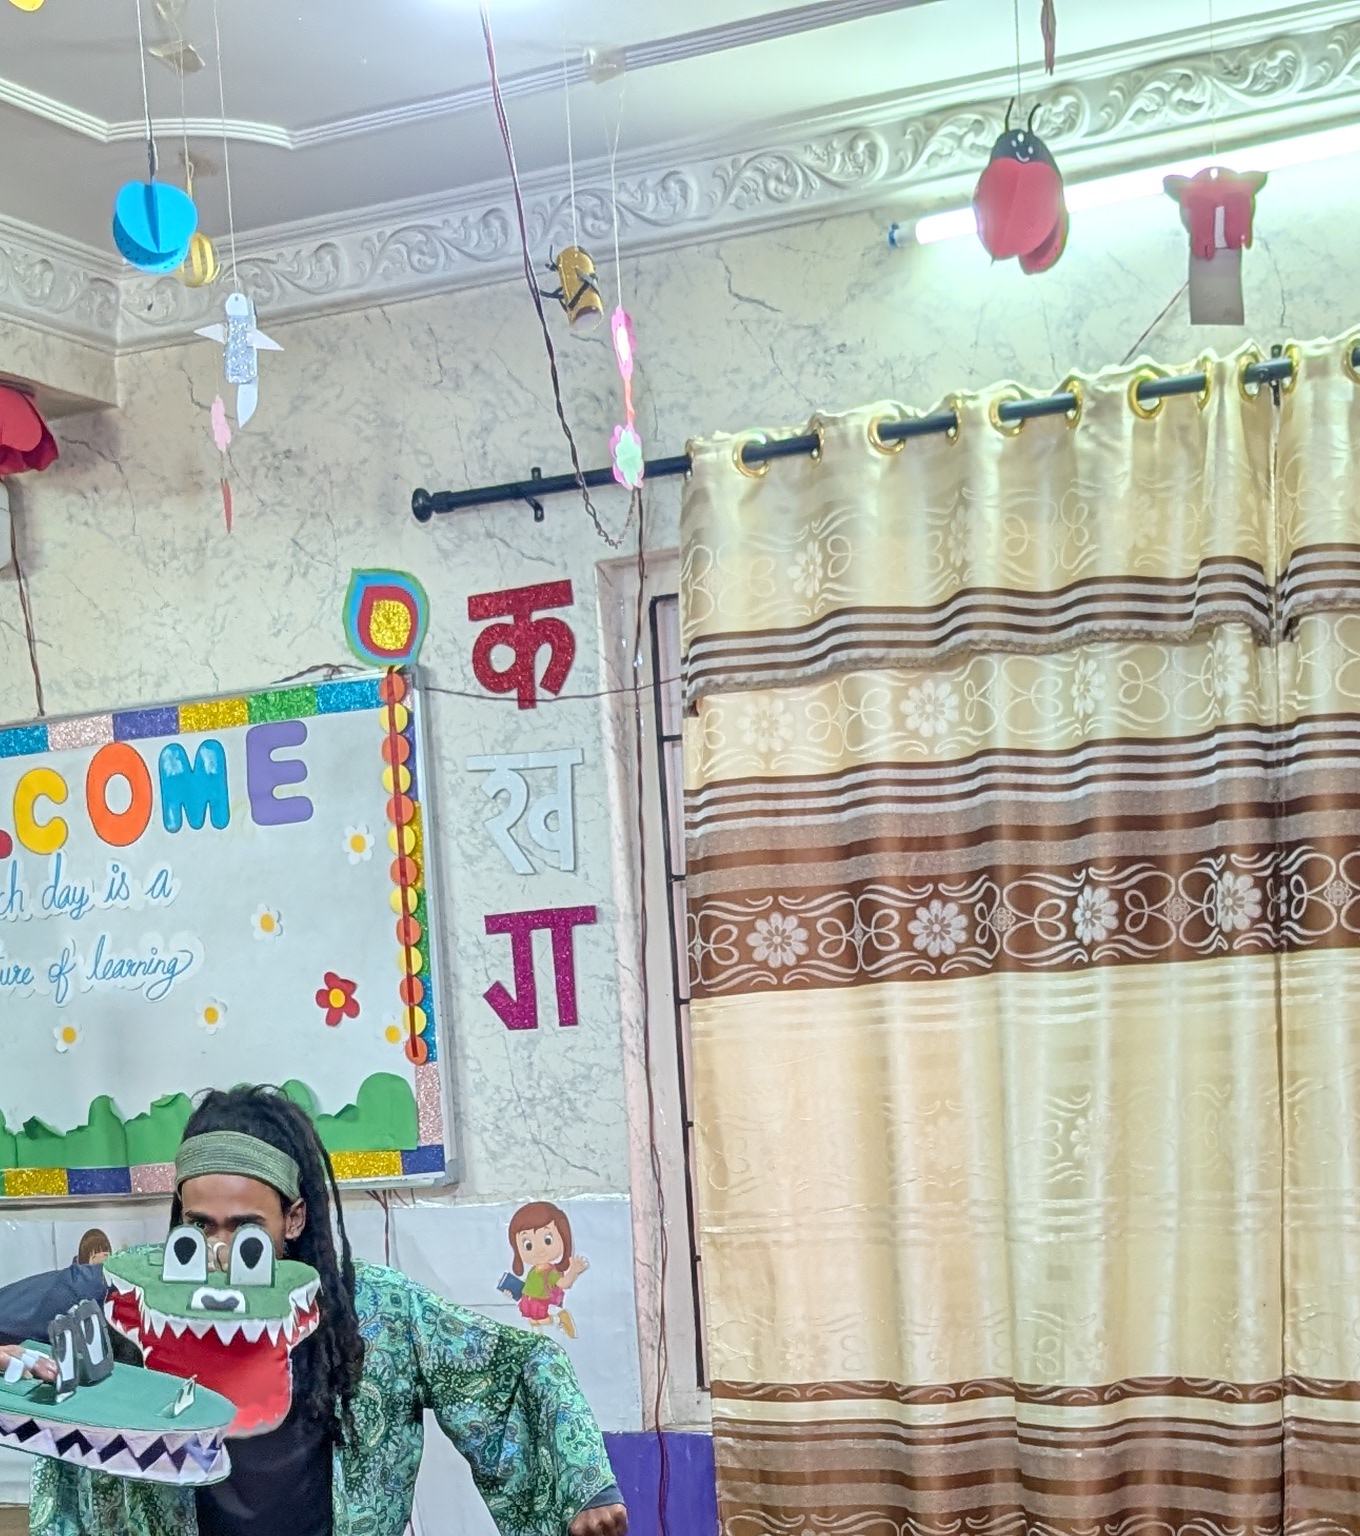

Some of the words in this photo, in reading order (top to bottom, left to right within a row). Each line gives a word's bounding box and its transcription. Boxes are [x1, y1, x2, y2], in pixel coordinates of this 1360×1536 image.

[468, 579, 576, 710] क
[467, 748, 584, 875] ख
[42, 852, 89, 920] day
[103, 863, 130, 903] is
[144, 869, 172, 899] a
[48, 947, 77, 1004] of
[86, 934, 194, 1002] learning
[483, 906, 598, 1031] ग
